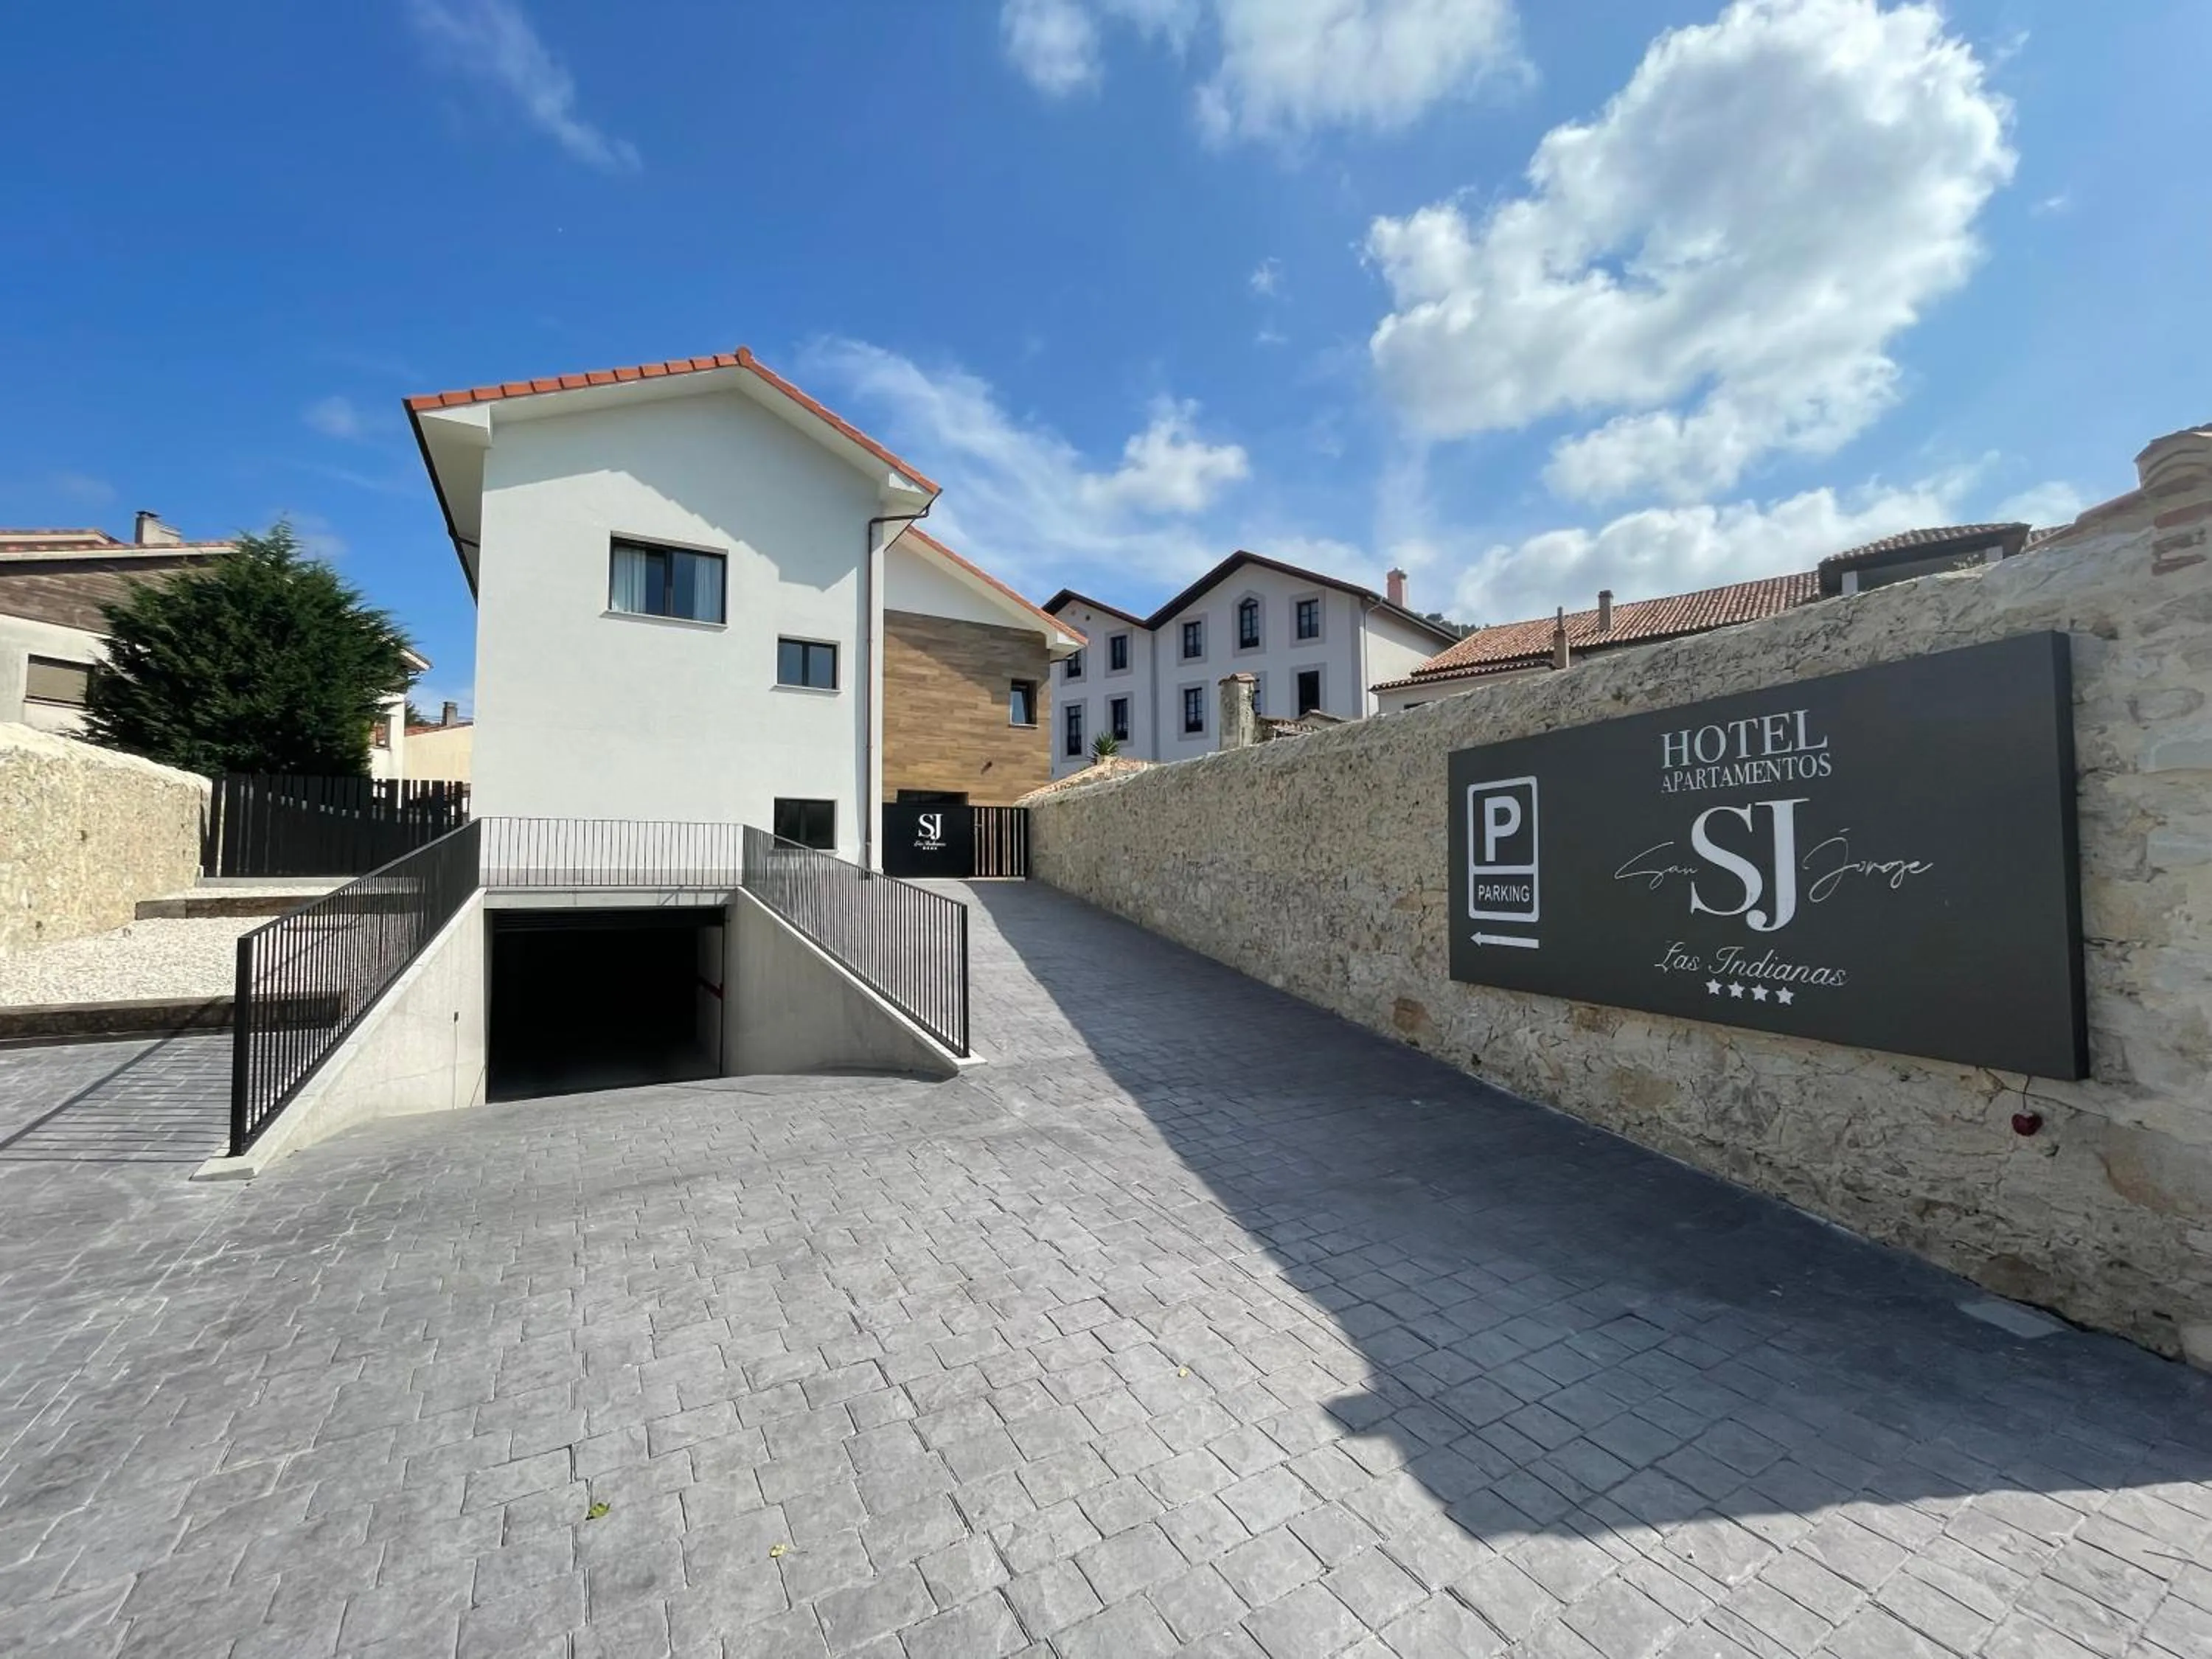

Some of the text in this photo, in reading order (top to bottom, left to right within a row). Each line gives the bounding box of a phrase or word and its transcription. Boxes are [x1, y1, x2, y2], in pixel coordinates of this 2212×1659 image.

[1660, 709, 1829, 769] HOTEL
[1660, 752, 1833, 793] APARTAMENTOS
[918, 813, 944, 841] SJ
[1484, 796, 1522, 863] P
[1614, 841, 1700, 891] San
[1689, 798, 1811, 932] SJ
[1478, 884, 1531, 903] PARKING
[1654, 941, 1848, 987] Las Indianas
